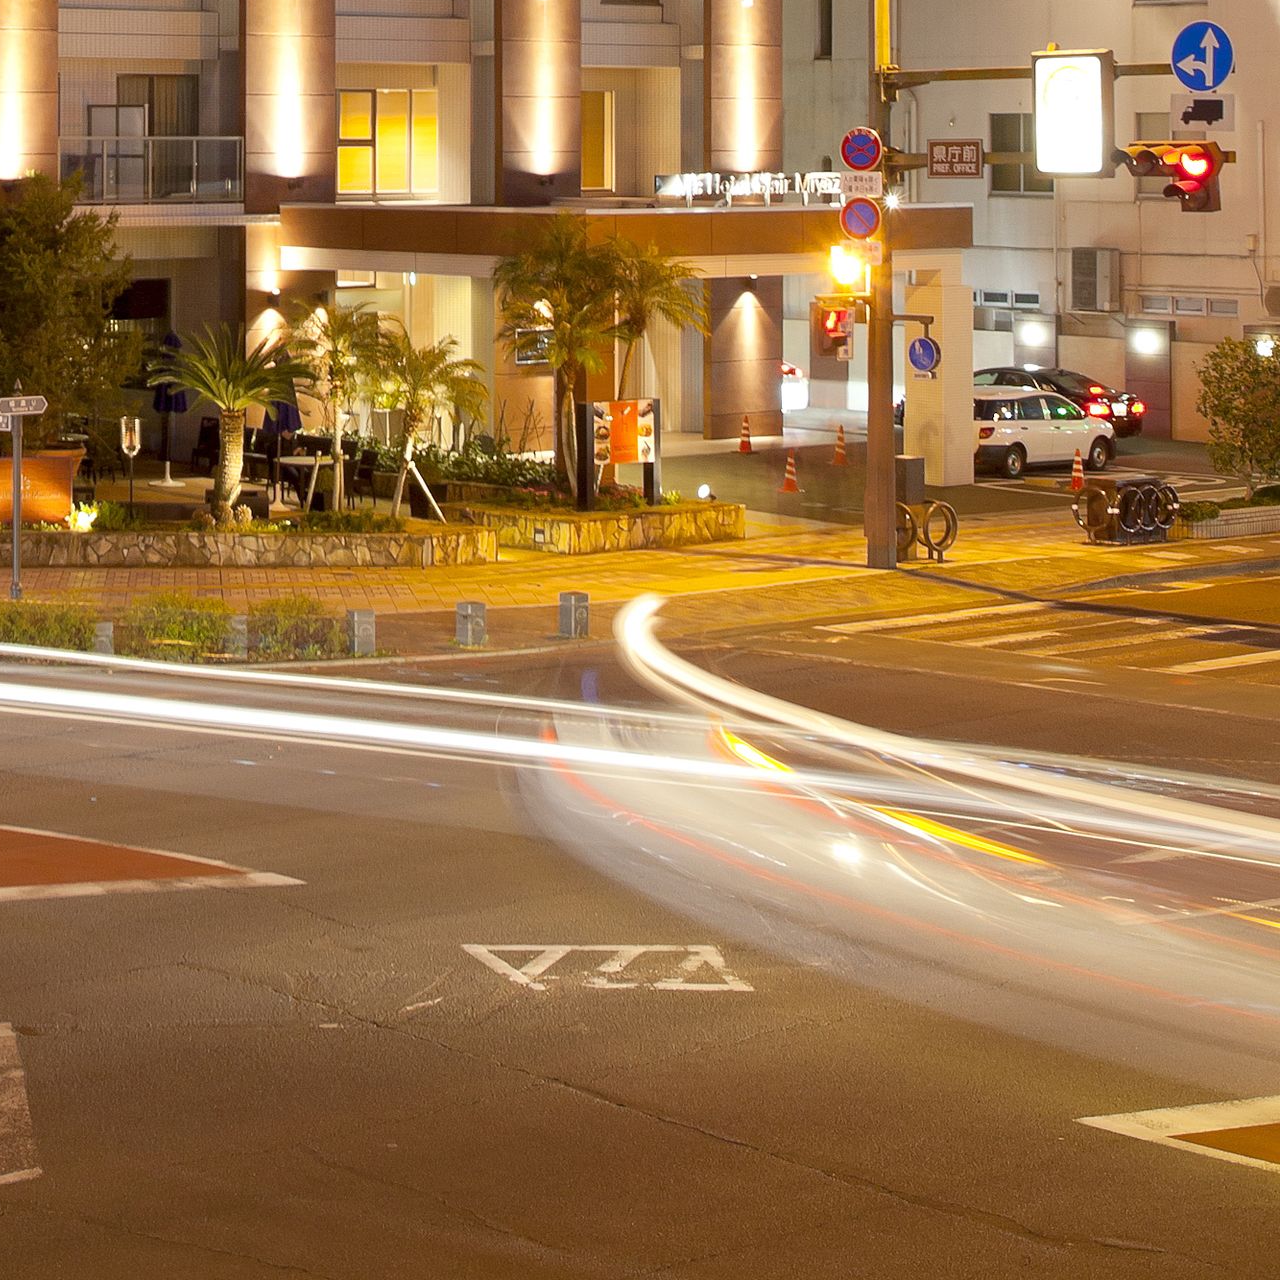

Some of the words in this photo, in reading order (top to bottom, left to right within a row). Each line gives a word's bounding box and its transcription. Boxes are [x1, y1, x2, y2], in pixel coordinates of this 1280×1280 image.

[933, 145, 976, 162] 県庁前
[953, 163, 977, 173] OFFICE
